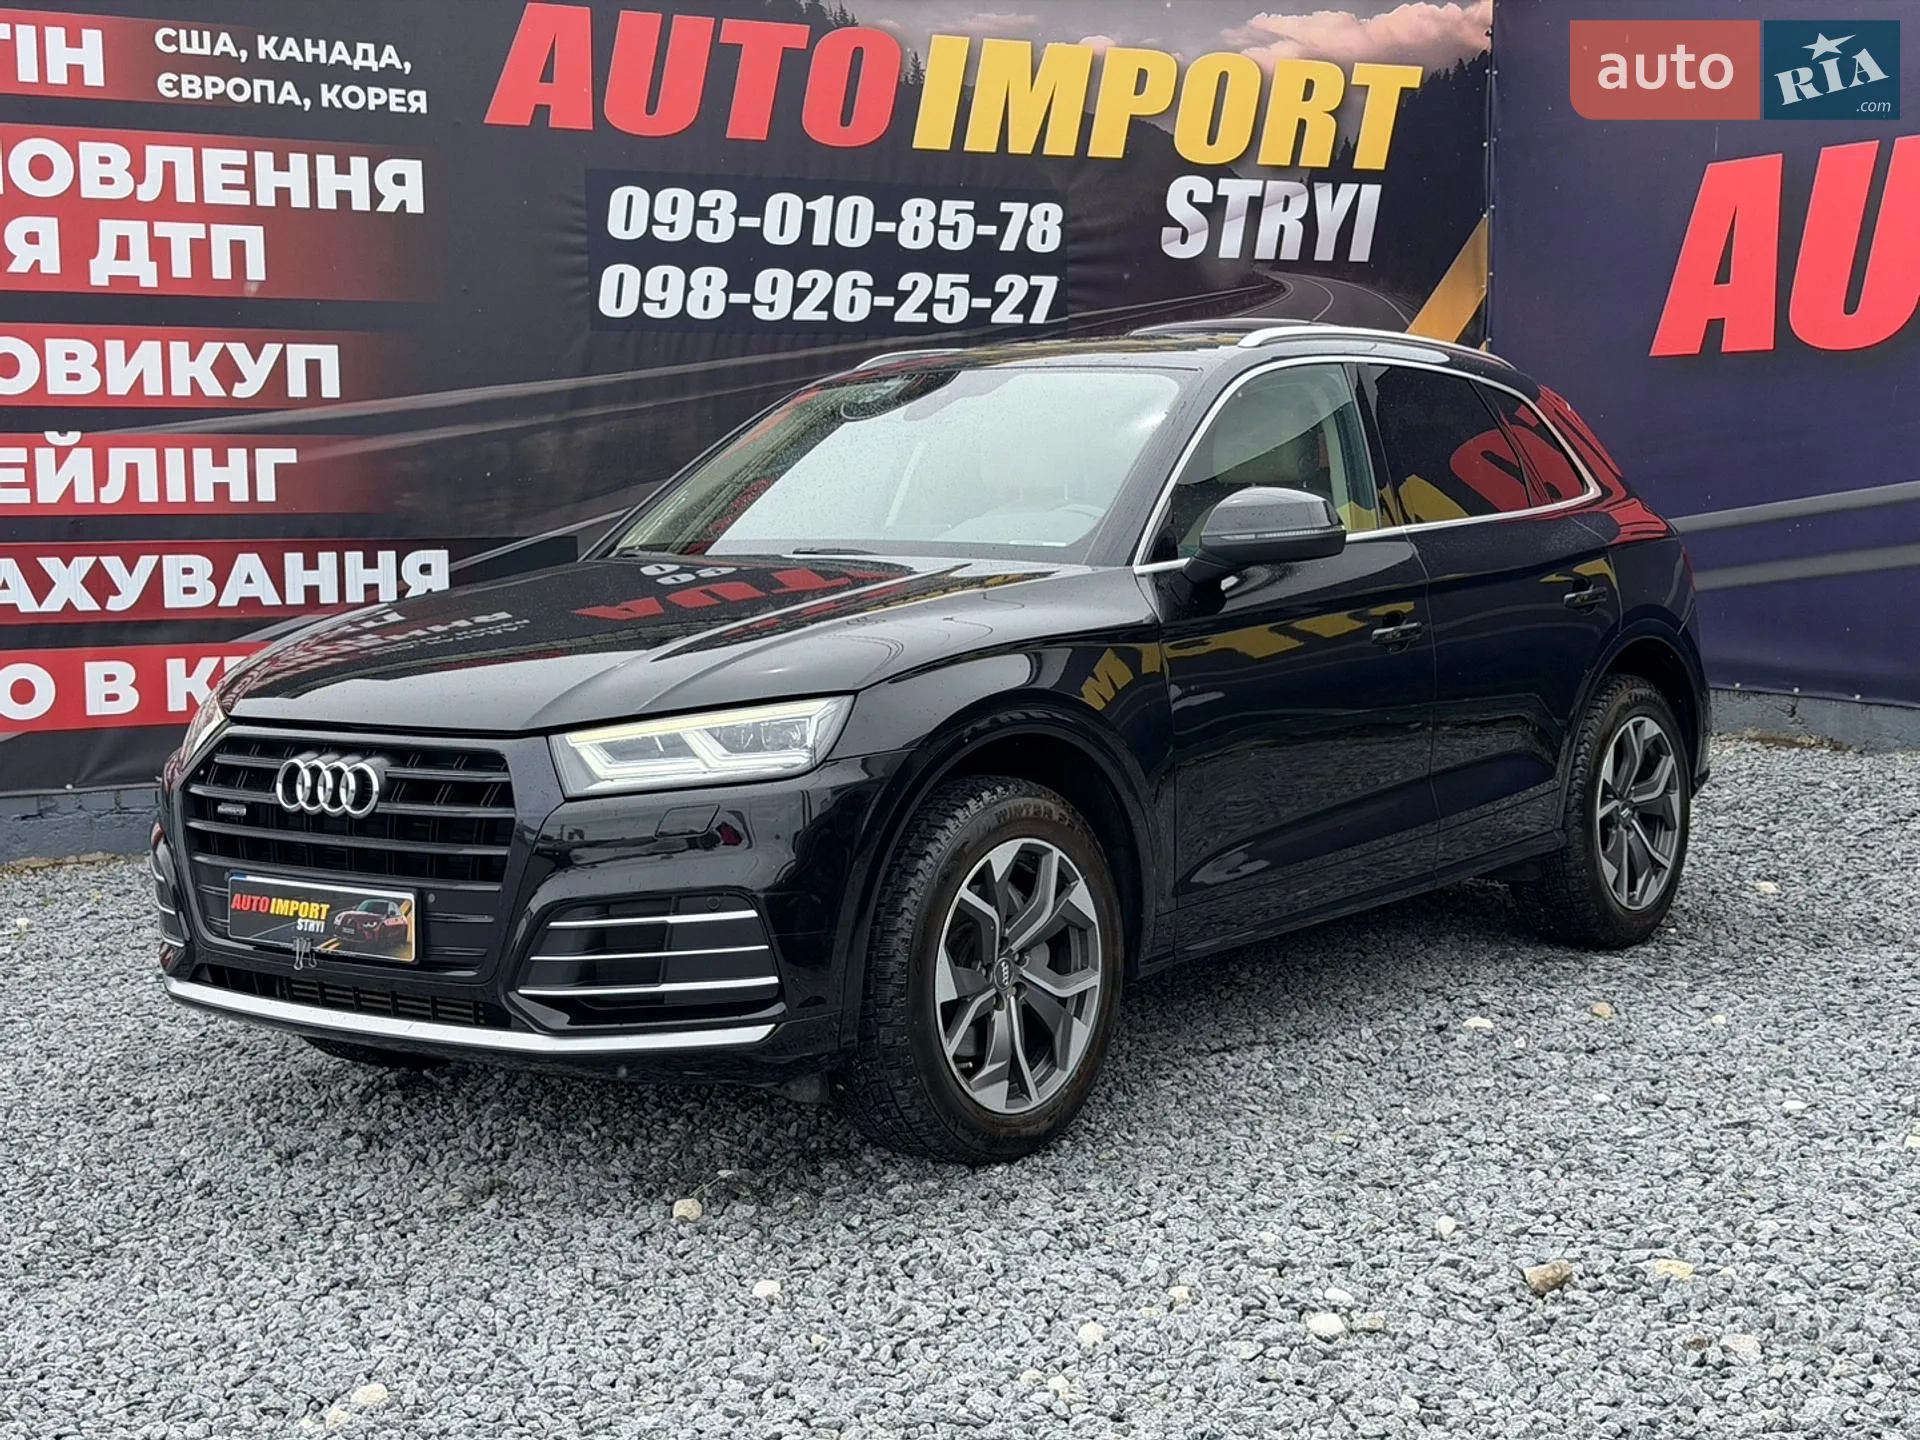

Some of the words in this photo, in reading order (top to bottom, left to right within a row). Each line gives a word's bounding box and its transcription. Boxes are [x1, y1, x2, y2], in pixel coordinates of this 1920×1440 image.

[154, 27, 248, 63] США,
[257, 35, 412, 75] КАНАДА,
[157, 72, 311, 111] ЄВРОПА,
[320, 83, 428, 114] КОРЕЯ
[0, 137, 425, 214] ОВЛЕННЯ
[607, 185, 1063, 253] 093-010-85-78
[1161, 175, 1382, 262] STRYI
[89, 219, 266, 288] ДТП
[598, 263, 1058, 324] 098-926-25-27
[0, 336, 341, 399] ОВИКУП
[0, 431, 298, 504] ЕЙЛІНГ
[0, 549, 450, 612] АХУВАННЯ
[84, 660, 140, 716] В
